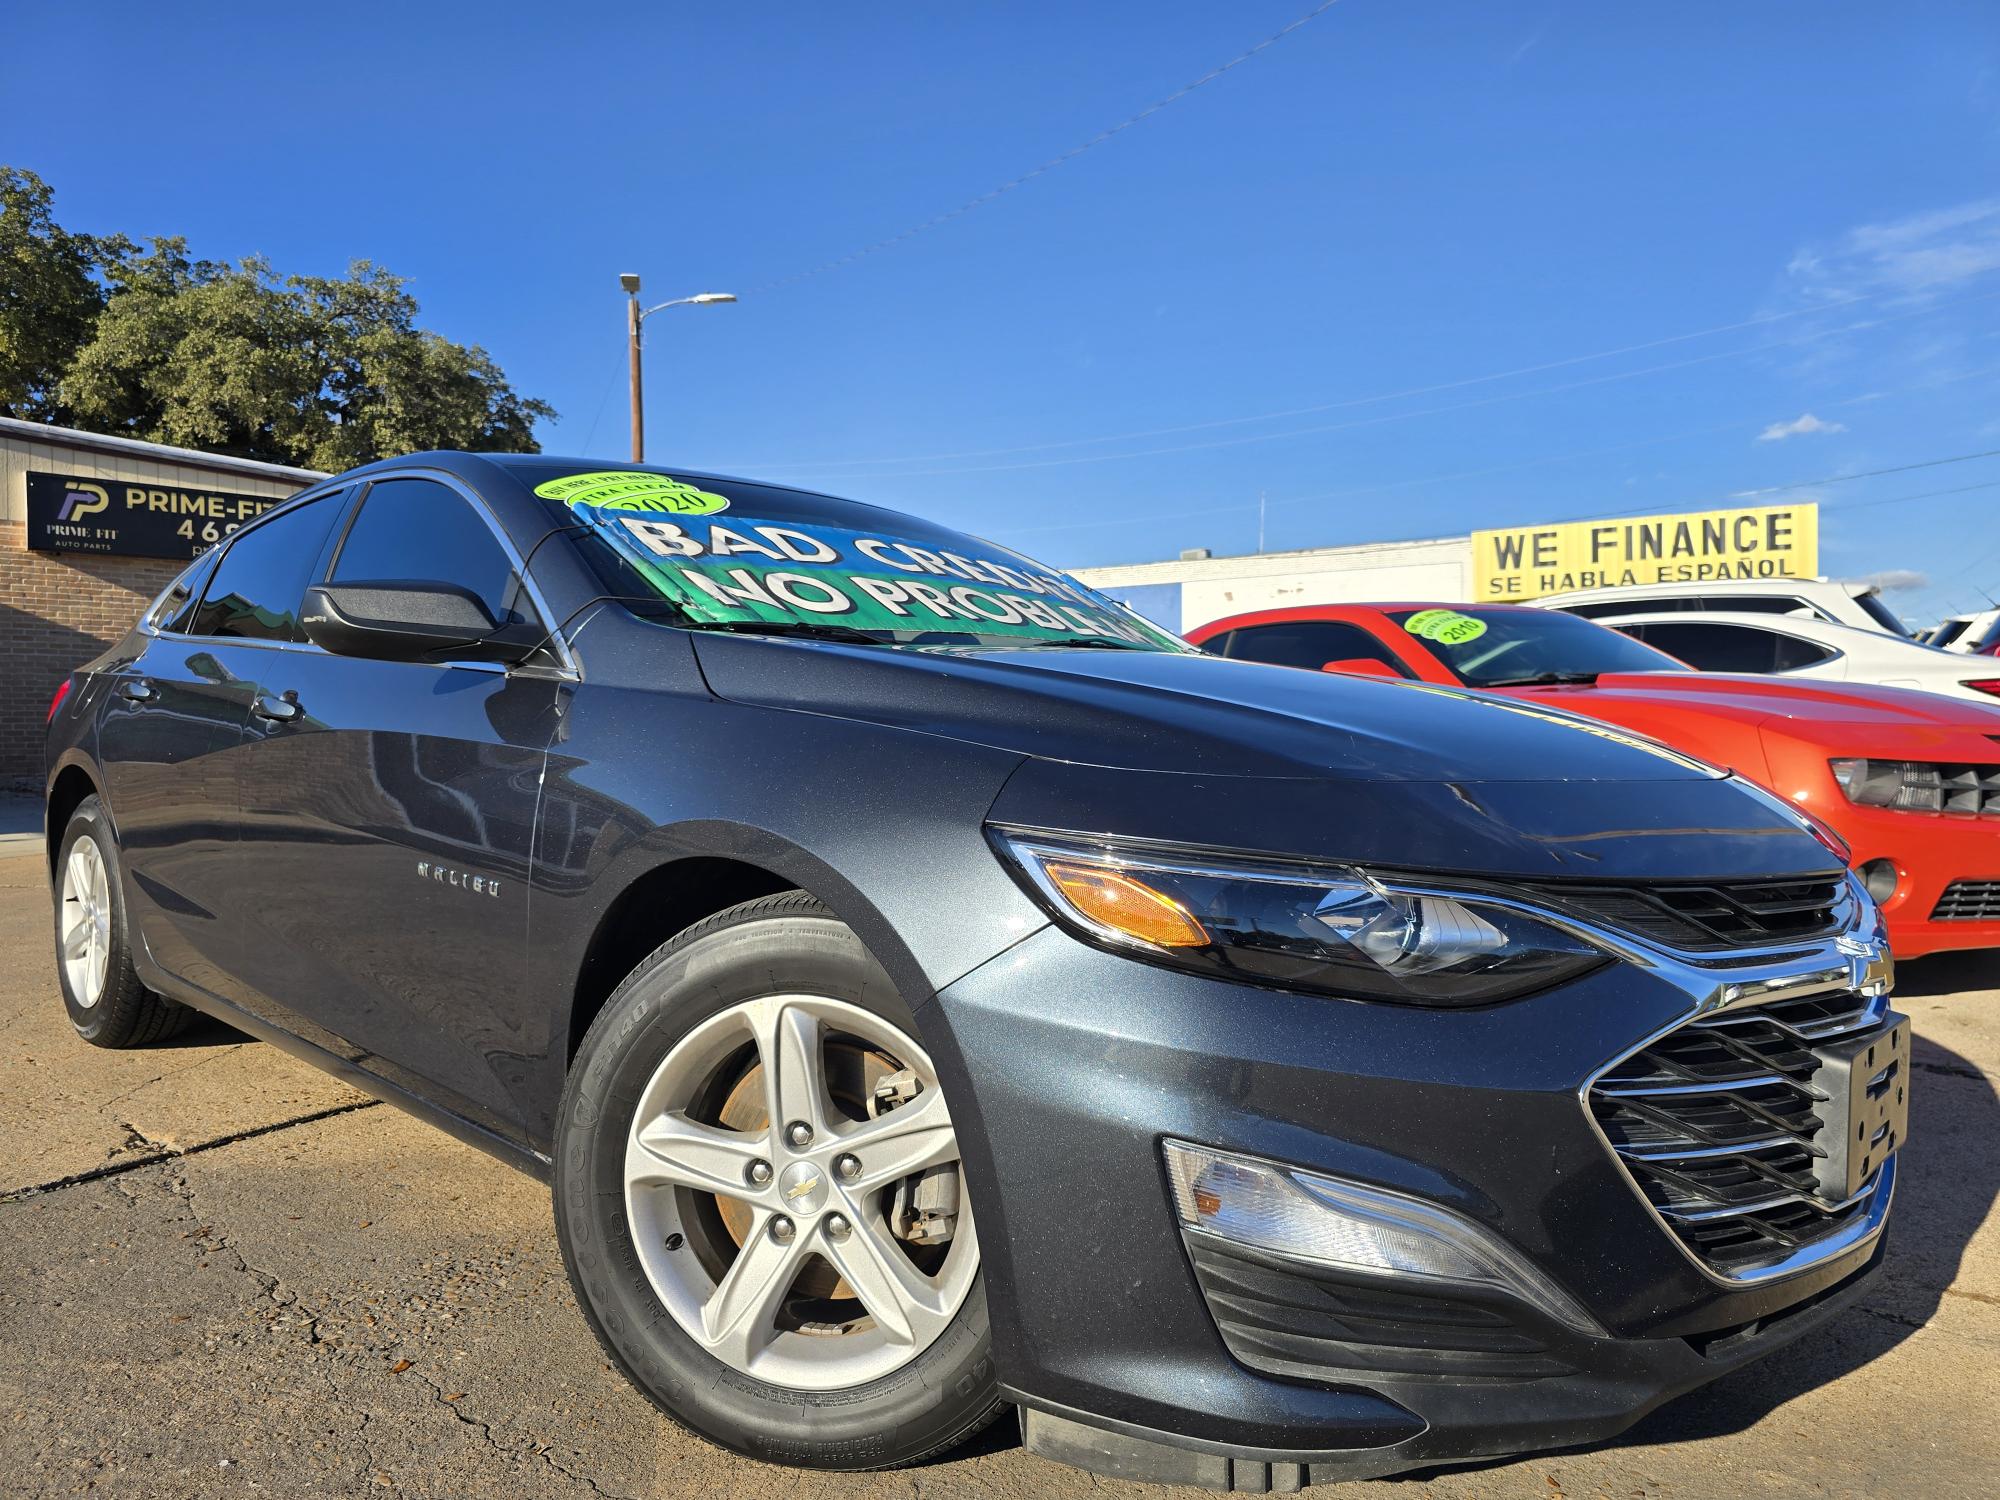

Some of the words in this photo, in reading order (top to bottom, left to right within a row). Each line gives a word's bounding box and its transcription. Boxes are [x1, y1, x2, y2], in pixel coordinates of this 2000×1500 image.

[46, 524, 92, 538] PRIME
[96, 528, 120, 540] FIT
[55, 540, 81, 549] AUTO
[83, 542, 113, 551] PARTS
[618, 516, 842, 565] BAD
[1493, 532, 1558, 570] WE
[1591, 512, 1793, 563] FINANCE
[681, 568, 853, 616] NO
[1490, 577, 1522, 594] SE
[1540, 568, 1638, 592] HABLA
[1657, 556, 1796, 583] ESPAÑOL
[1443, 620, 1480, 641] 2010
[417, 862, 501, 898] MALIBU
